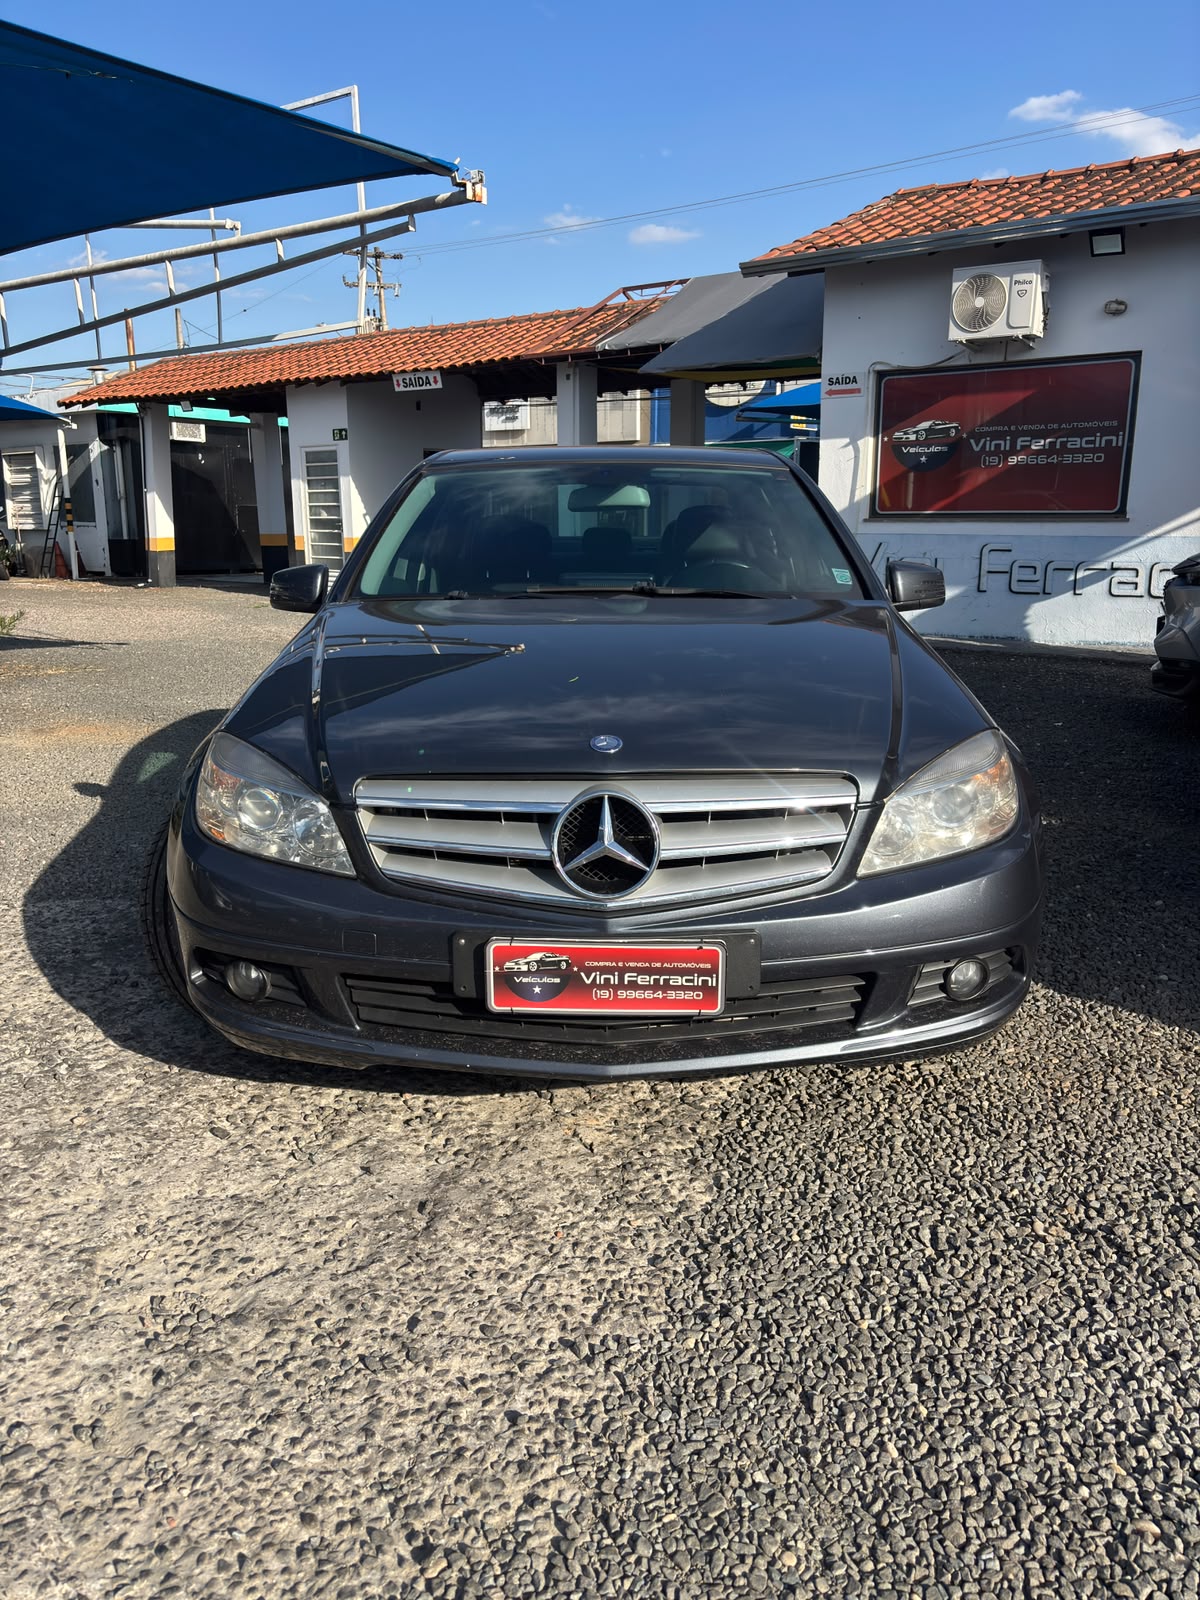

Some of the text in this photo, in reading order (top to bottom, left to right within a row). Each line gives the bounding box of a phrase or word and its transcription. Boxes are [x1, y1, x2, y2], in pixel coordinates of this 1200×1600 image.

[402, 374, 432, 389] SAÍDA
[827, 373, 858, 386] SAÍDA
[974, 424, 1009, 433] COMPRA
[1017, 423, 1046, 431] VENDA
[1047, 422, 1059, 430] DE
[1060, 419, 1118, 429] AUTOMÓVEIS
[970, 431, 1124, 452] Vini Ferracini
[901, 444, 949, 453] Veículos
[980, 452, 1105, 468] (19) 99664-3320
[662, 961, 712, 969] AUTOMÓVEIS
[513, 975, 561, 984] Veículos
[580, 971, 717, 987] Vini Ferracini
[592, 989, 703, 1000] (19) 99664-3320
